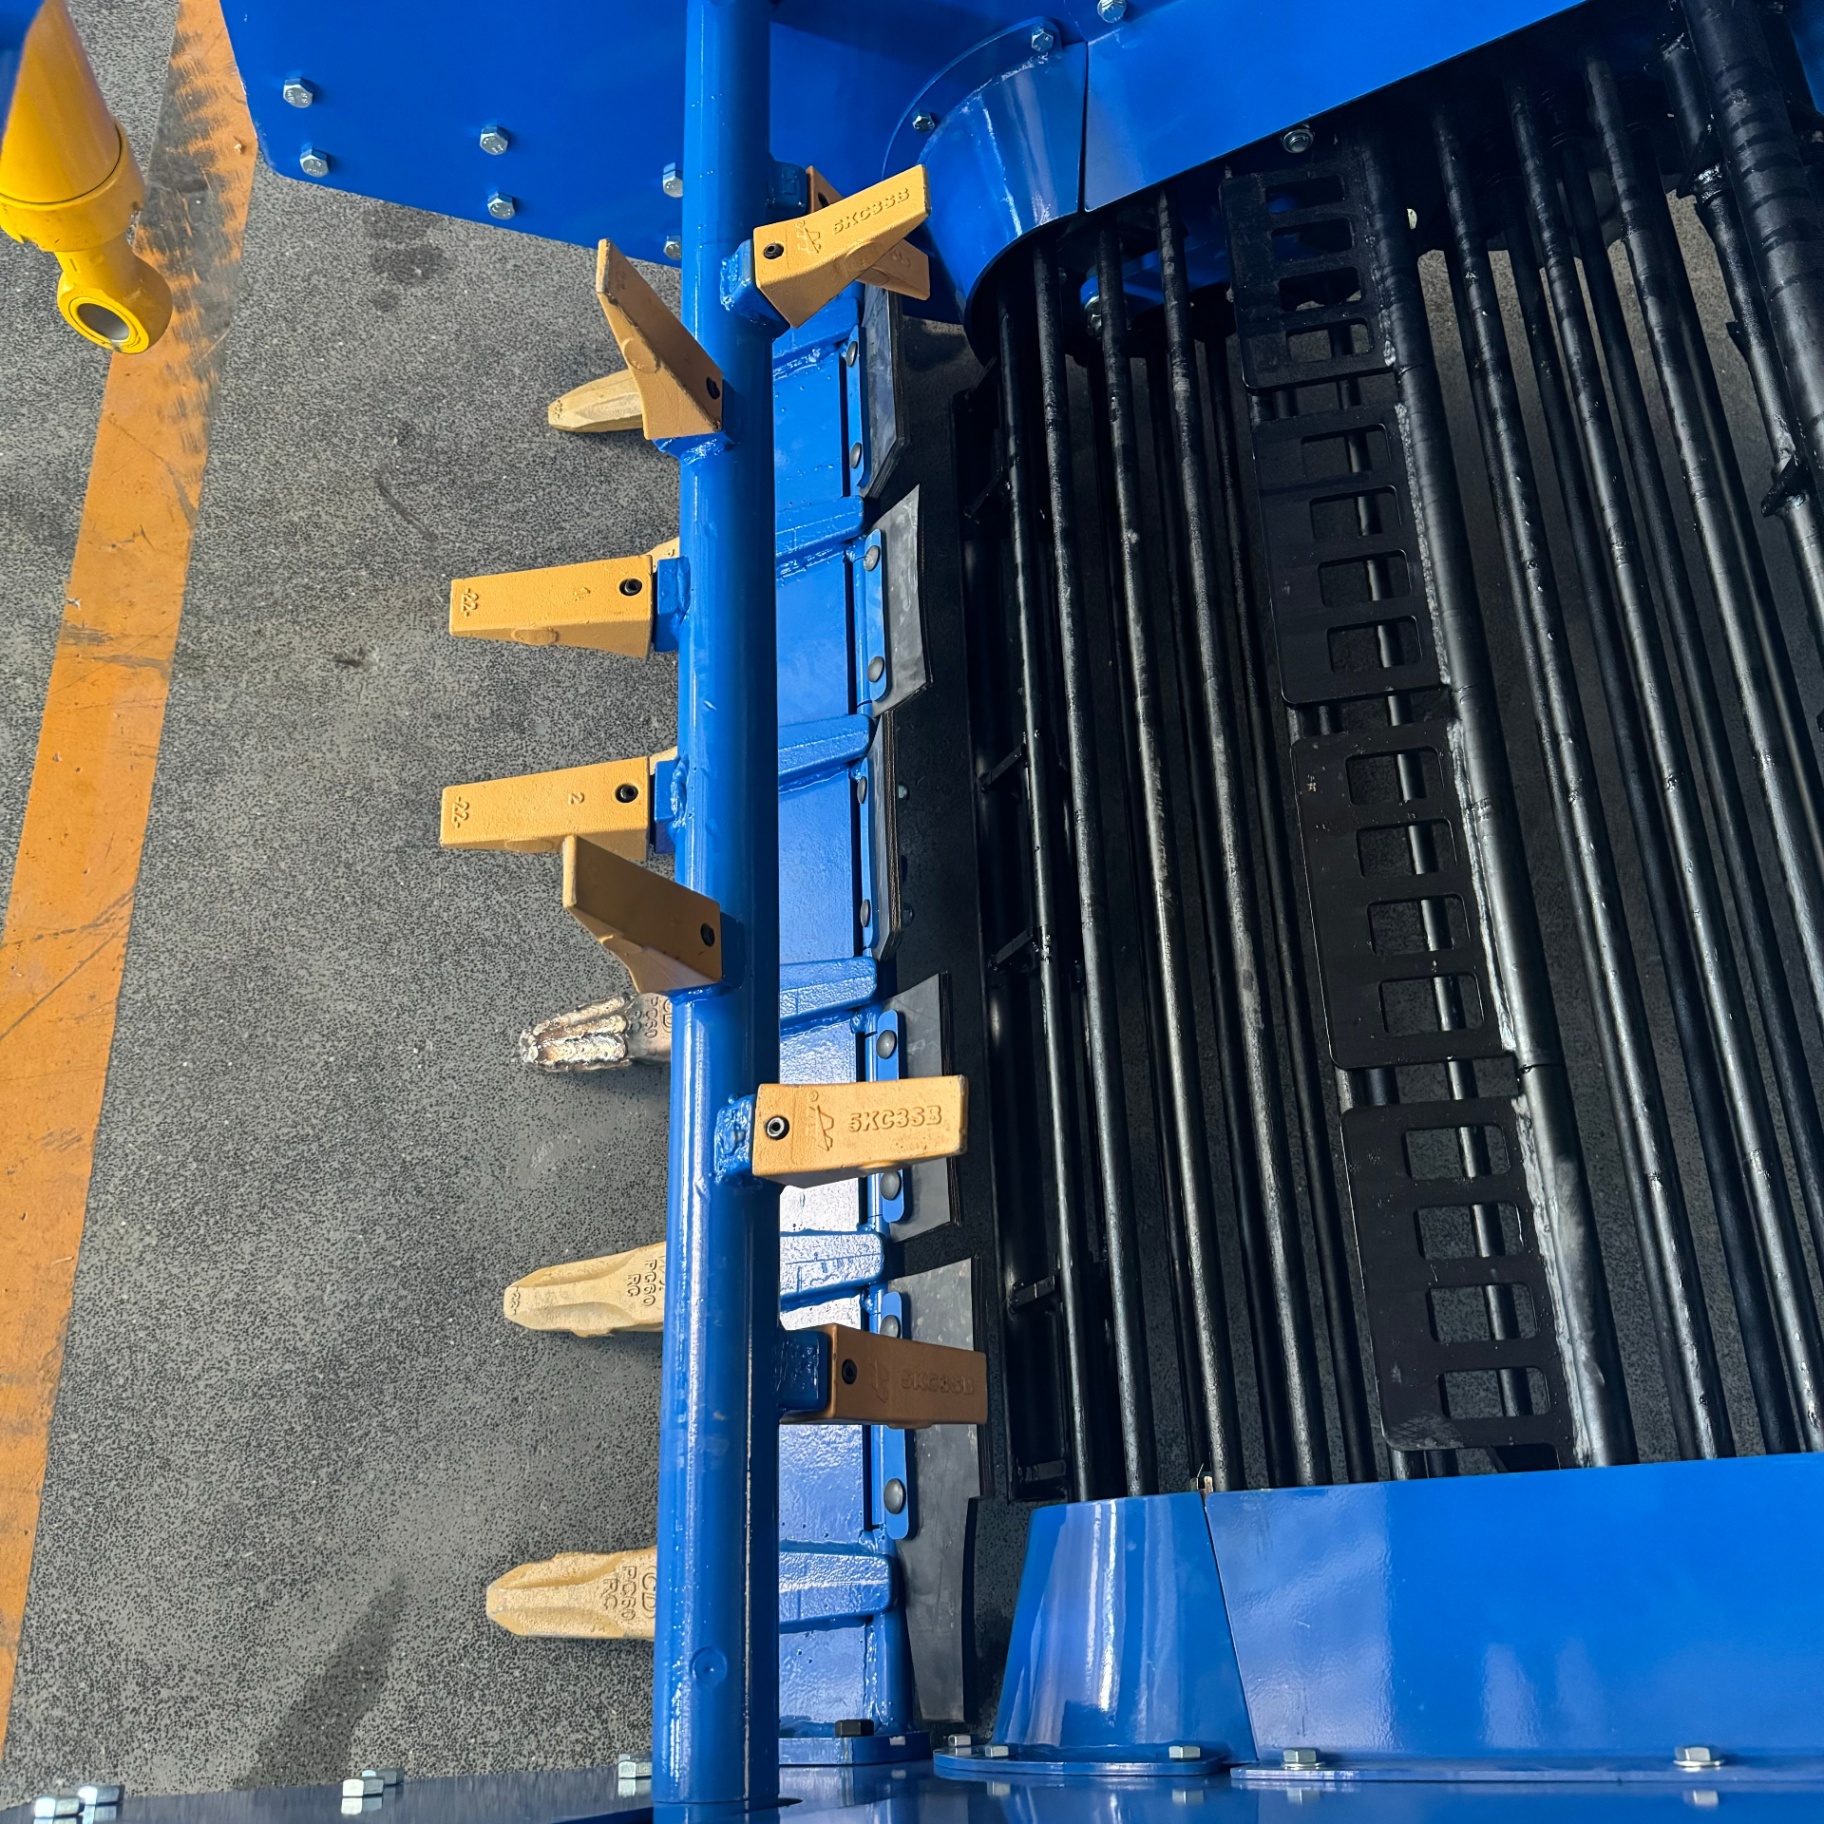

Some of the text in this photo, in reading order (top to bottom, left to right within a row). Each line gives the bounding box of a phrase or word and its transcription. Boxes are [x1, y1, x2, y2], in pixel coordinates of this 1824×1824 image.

[627, 1273, 641, 1297] RC
[643, 1259, 657, 1306] PC60
[601, 1578, 618, 1610] RC
